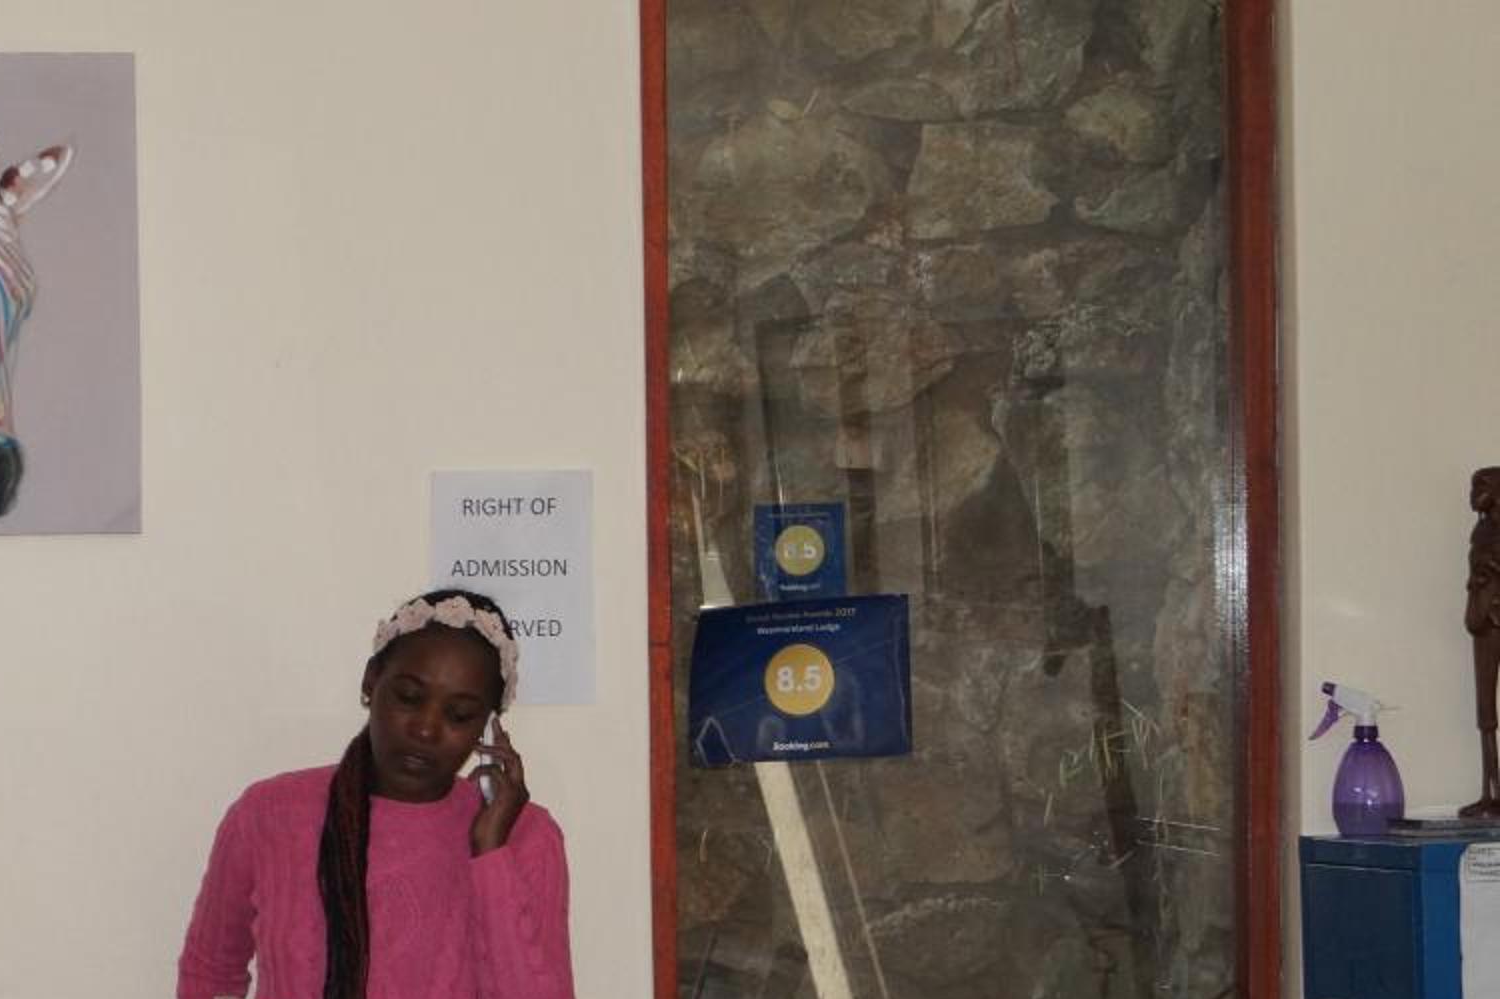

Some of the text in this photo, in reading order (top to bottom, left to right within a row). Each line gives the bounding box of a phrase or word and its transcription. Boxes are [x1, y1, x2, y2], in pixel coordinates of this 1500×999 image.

[462, 498, 557, 516] RIGHT OF
[451, 559, 568, 577] ADMISSION
[508, 619, 563, 637] RVED
[776, 665, 822, 692] 8.5
